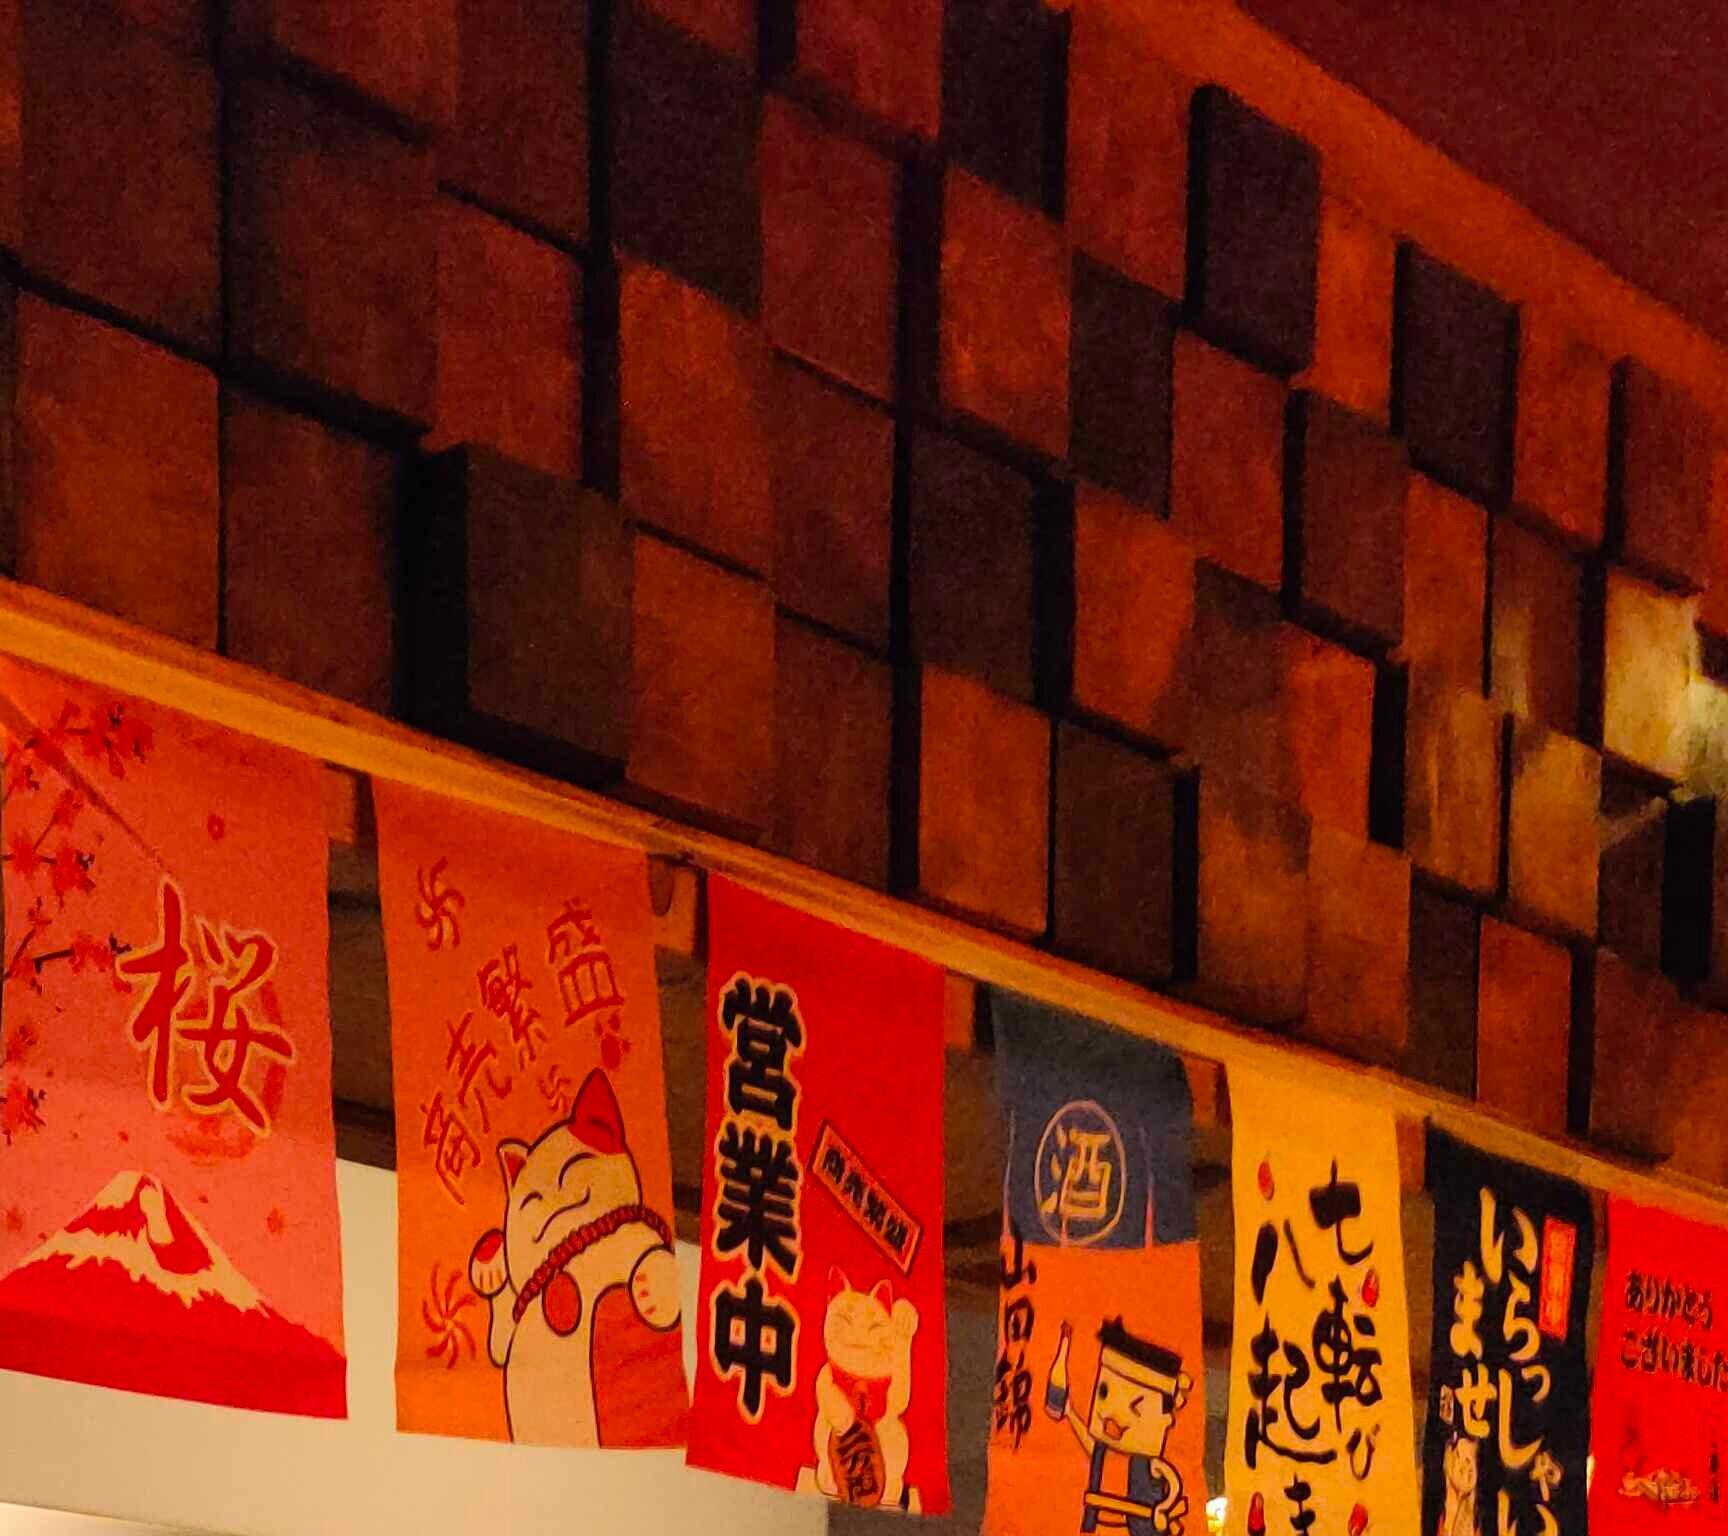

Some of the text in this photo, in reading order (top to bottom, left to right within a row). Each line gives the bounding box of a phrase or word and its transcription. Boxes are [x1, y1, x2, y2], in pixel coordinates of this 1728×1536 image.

[120, 882, 293, 1133] 桜
[713, 975, 803, 1417] 営業中
[1040, 1129, 1113, 1223] 酒
[1309, 1160, 1383, 1480] 七転び
[1450, 1259, 1497, 1439] ませ
